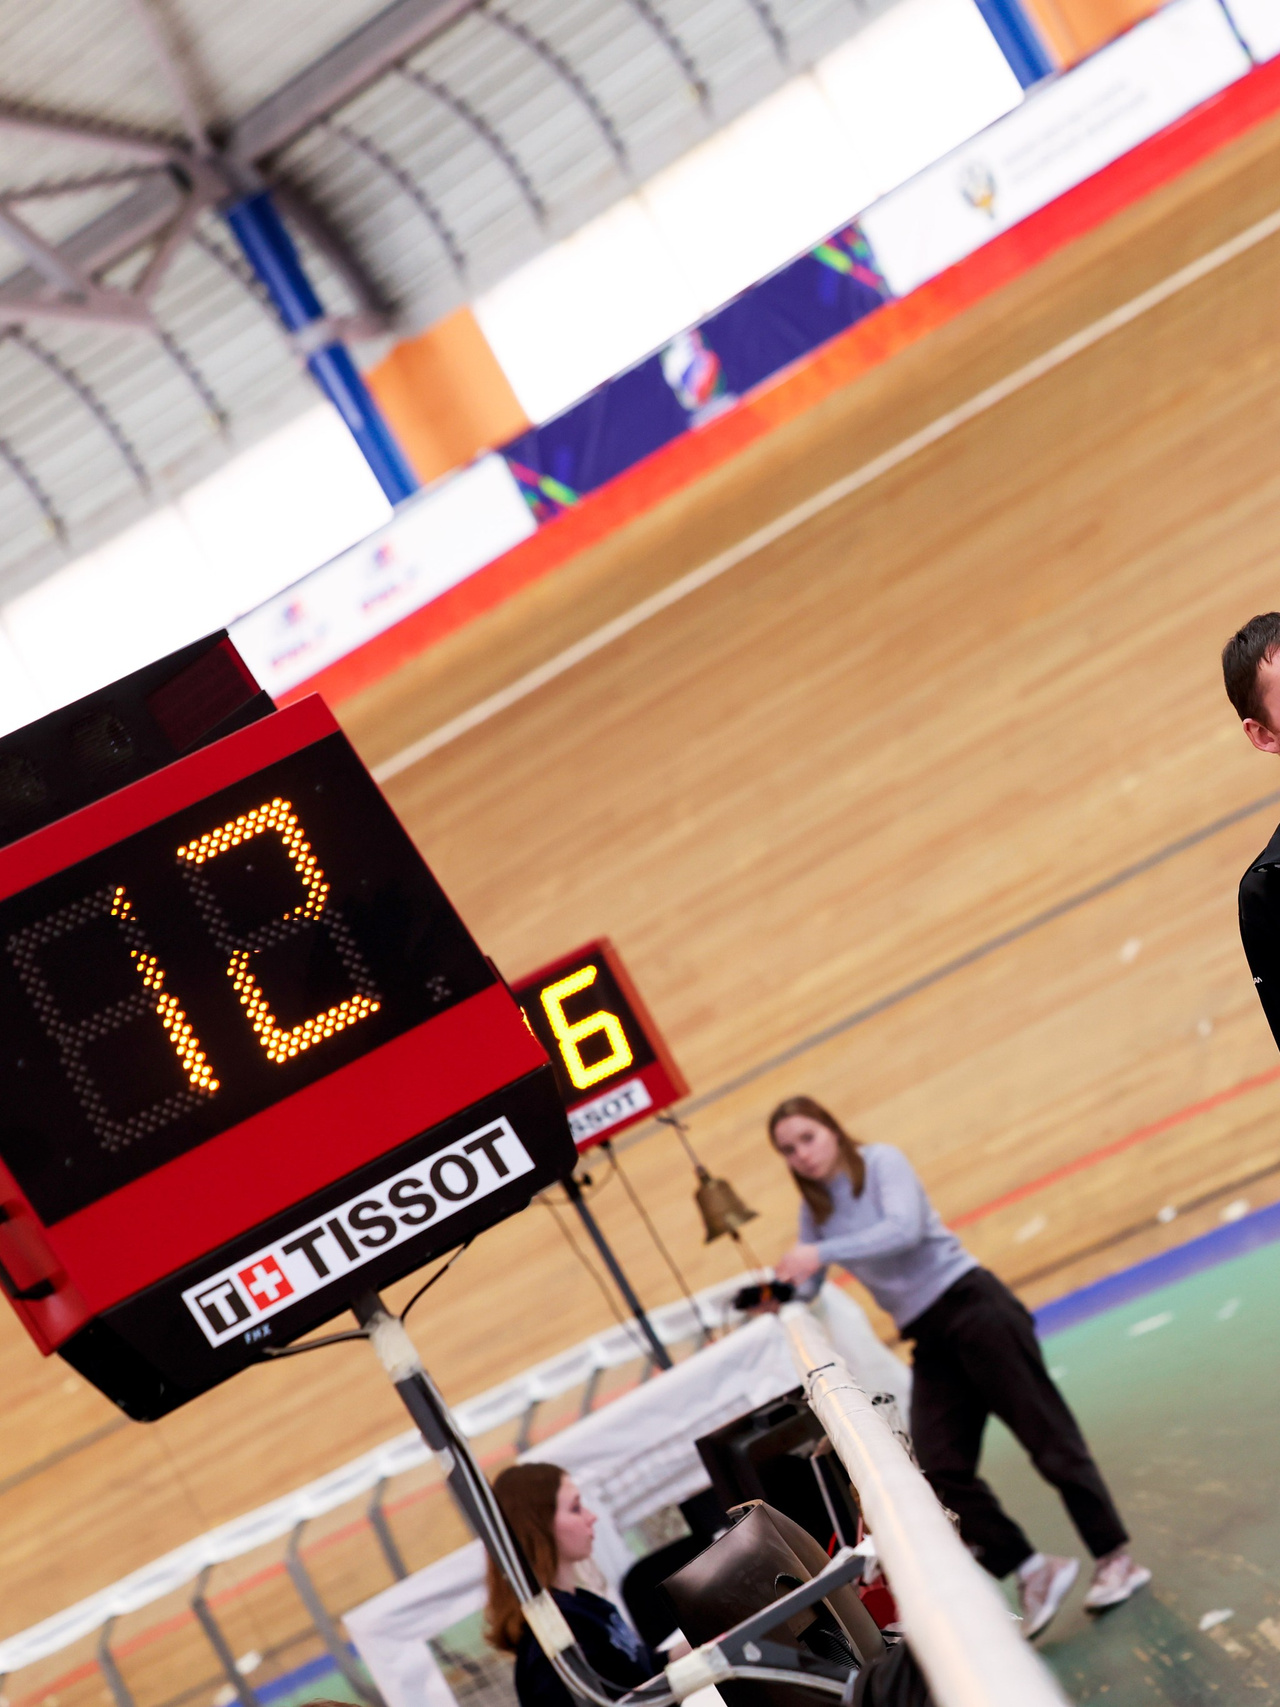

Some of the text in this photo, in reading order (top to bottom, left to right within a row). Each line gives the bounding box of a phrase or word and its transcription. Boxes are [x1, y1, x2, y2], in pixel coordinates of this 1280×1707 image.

[111, 797, 381, 1091] 12
[538, 964, 633, 1090] 6
[282, 1126, 510, 1279] TISSOT
